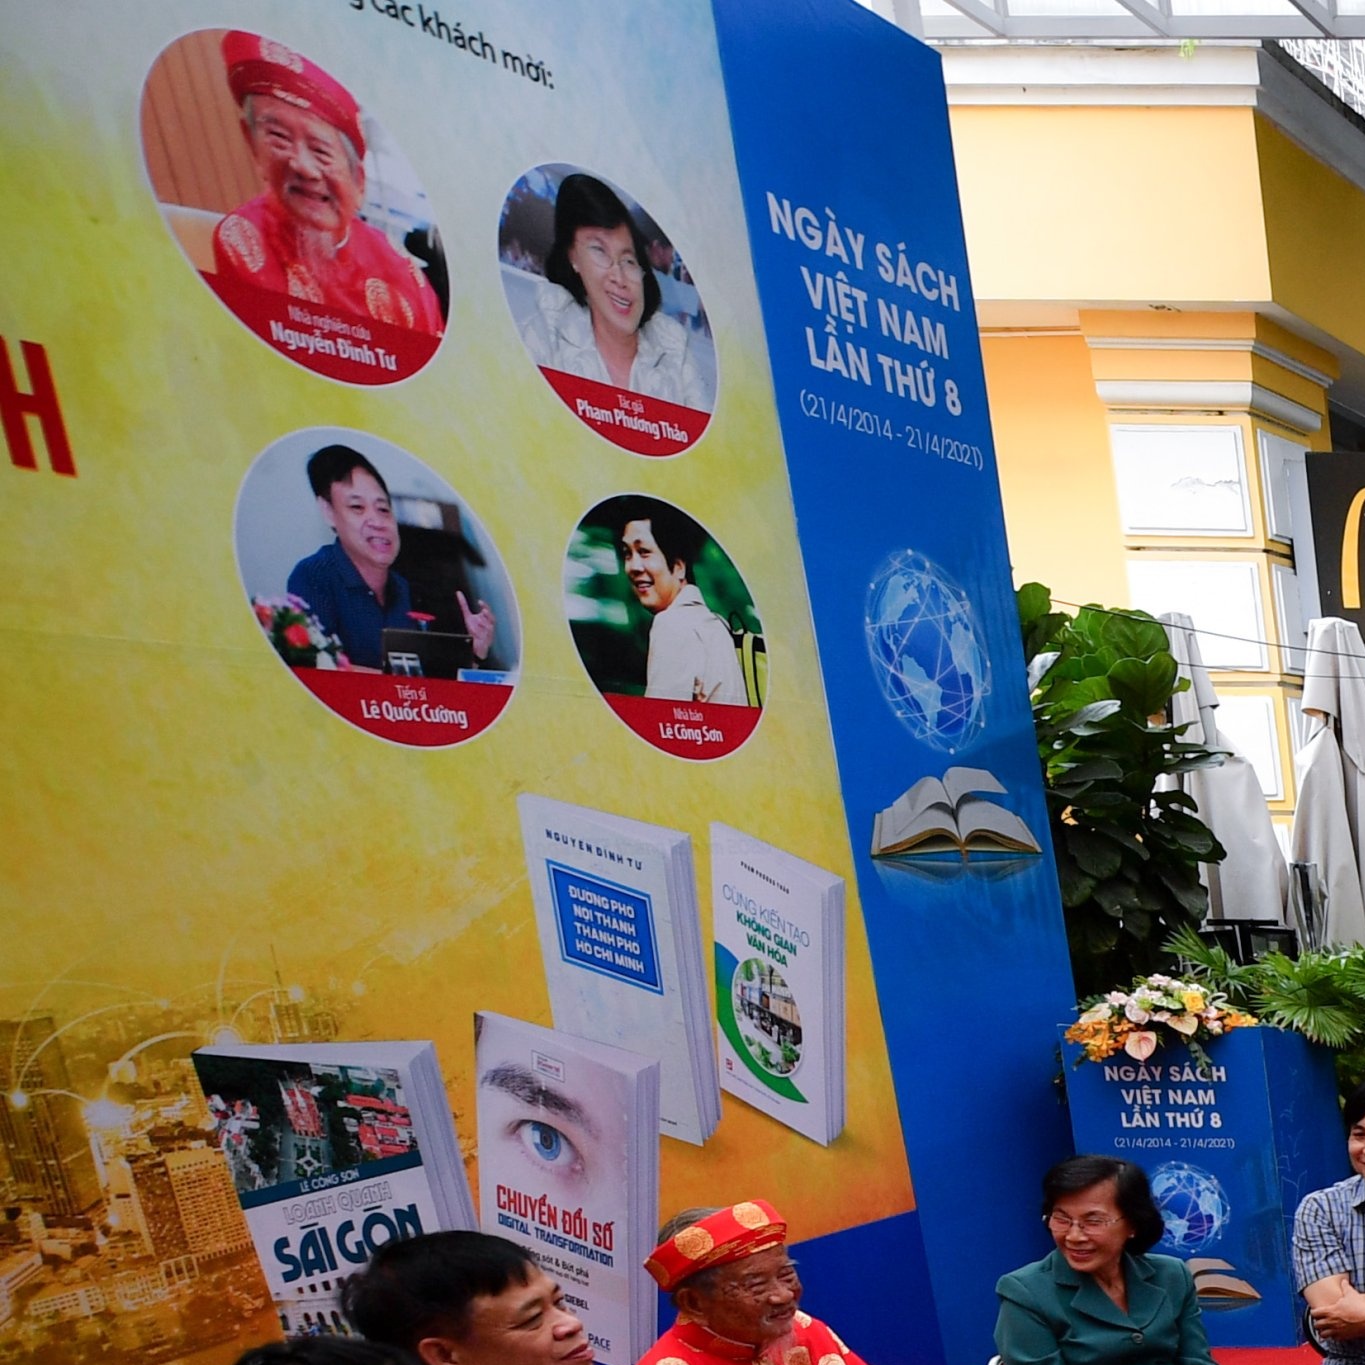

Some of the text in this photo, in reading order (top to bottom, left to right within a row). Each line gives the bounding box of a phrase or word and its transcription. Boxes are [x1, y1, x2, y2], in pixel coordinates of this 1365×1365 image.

[418, 4, 497, 64] khách
[501, 49, 554, 90] mời:
[766, 191, 961, 312] NGÀY SÁCH
[800, 266, 949, 360] VIỆT NAM
[269, 320, 336, 355] Nguyễn
[375, 348, 397, 371] Tư
[804, 313, 963, 417] LẦN THỨ 8
[576, 398, 689, 443] Phạm Phương Thảo
[800, 388, 893, 441] (21/4/2014
[905, 425, 984, 472] 21/4/2021)
[360, 699, 469, 730] Lê Quốc Cường
[658, 722, 724, 745] Lê Công Sơn
[773, 932, 798, 957] GIAN
[1104, 1061, 1227, 1082] NGÀY SÁCH
[1120, 1085, 1216, 1110] VIỆT NAM
[1120, 1104, 1222, 1129] LẦN THỨ 8
[1114, 1136, 1172, 1149] (21/4/2014
[1180, 1137, 1236, 1149] 21/4/2021)
[281, 1195, 338, 1227] LOANH
[497, 1211, 615, 1268] DIGITAL TRANSFORMATION
[591, 1220, 616, 1252] SỐ
[587, 1331, 612, 1351] PACE
